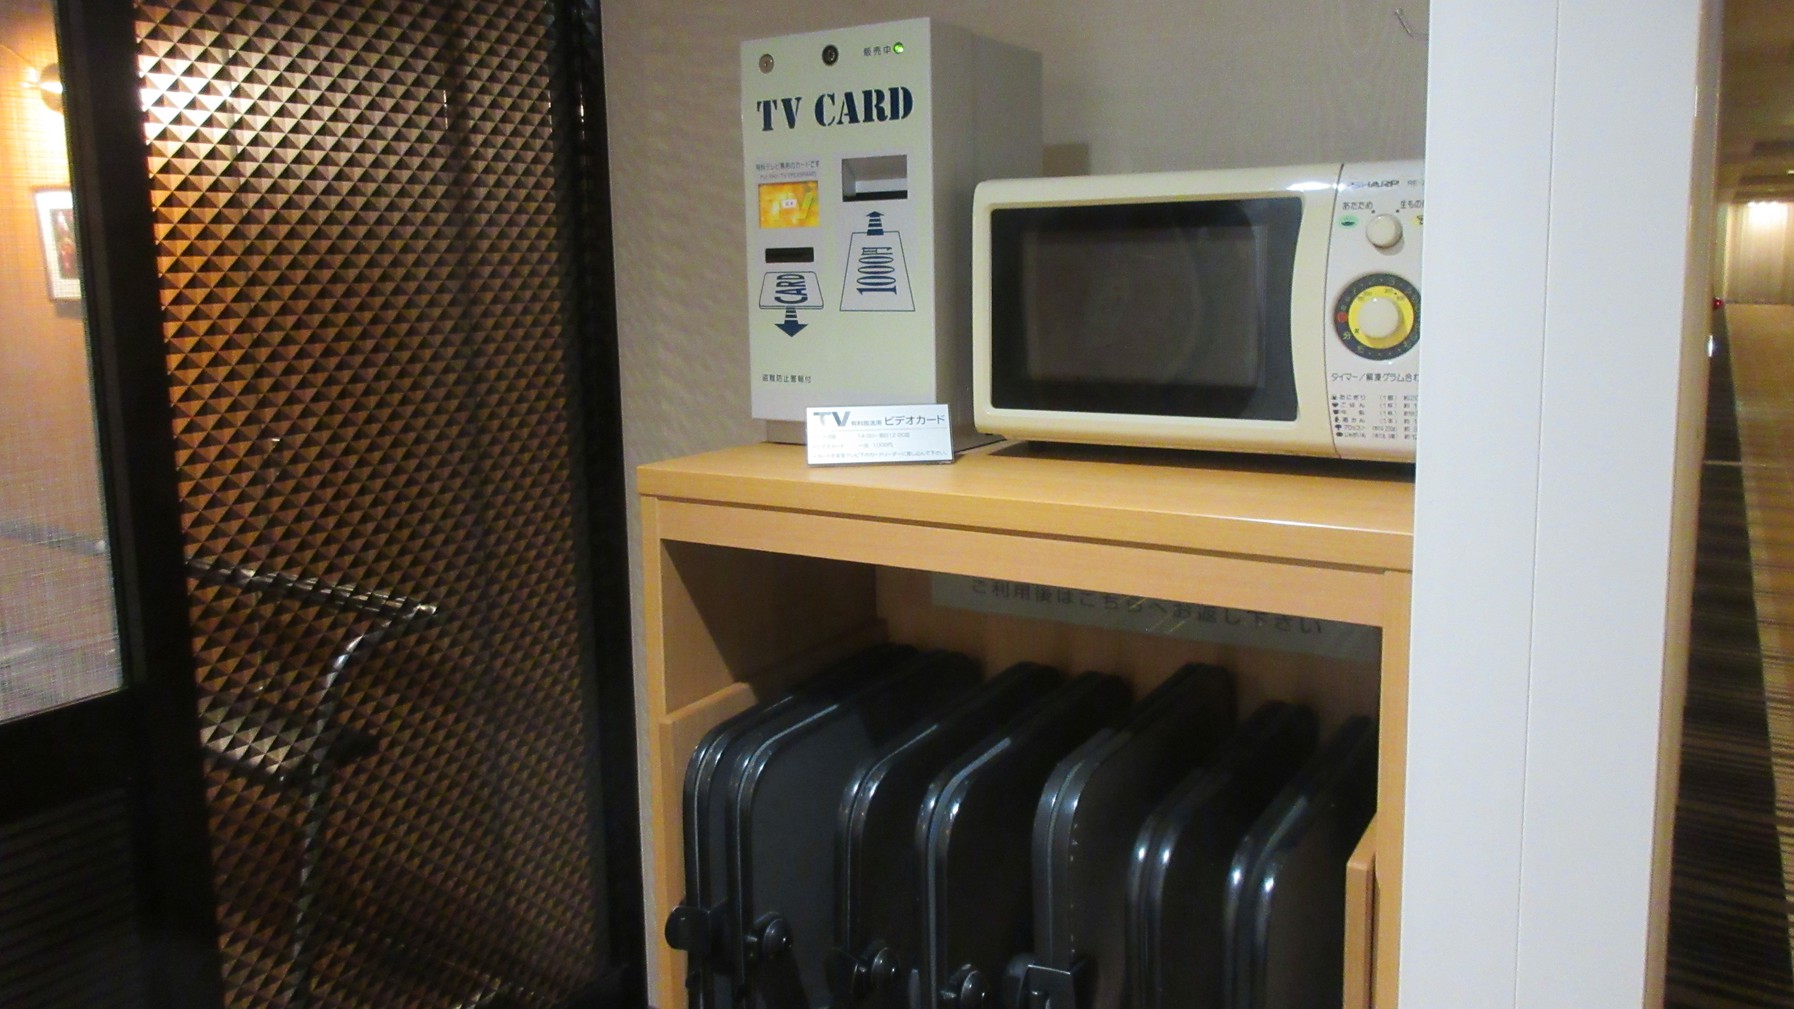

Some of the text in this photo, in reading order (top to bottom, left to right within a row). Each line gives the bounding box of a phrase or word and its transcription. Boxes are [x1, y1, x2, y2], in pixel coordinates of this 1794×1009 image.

[863, 45, 892, 57] 販売中
[756, 86, 913, 131] TV CARD
[856, 246, 898, 295] 1000円
[774, 273, 808, 304] CARD
[813, 411, 851, 427] TV
[884, 415, 946, 426] ビデオカード
